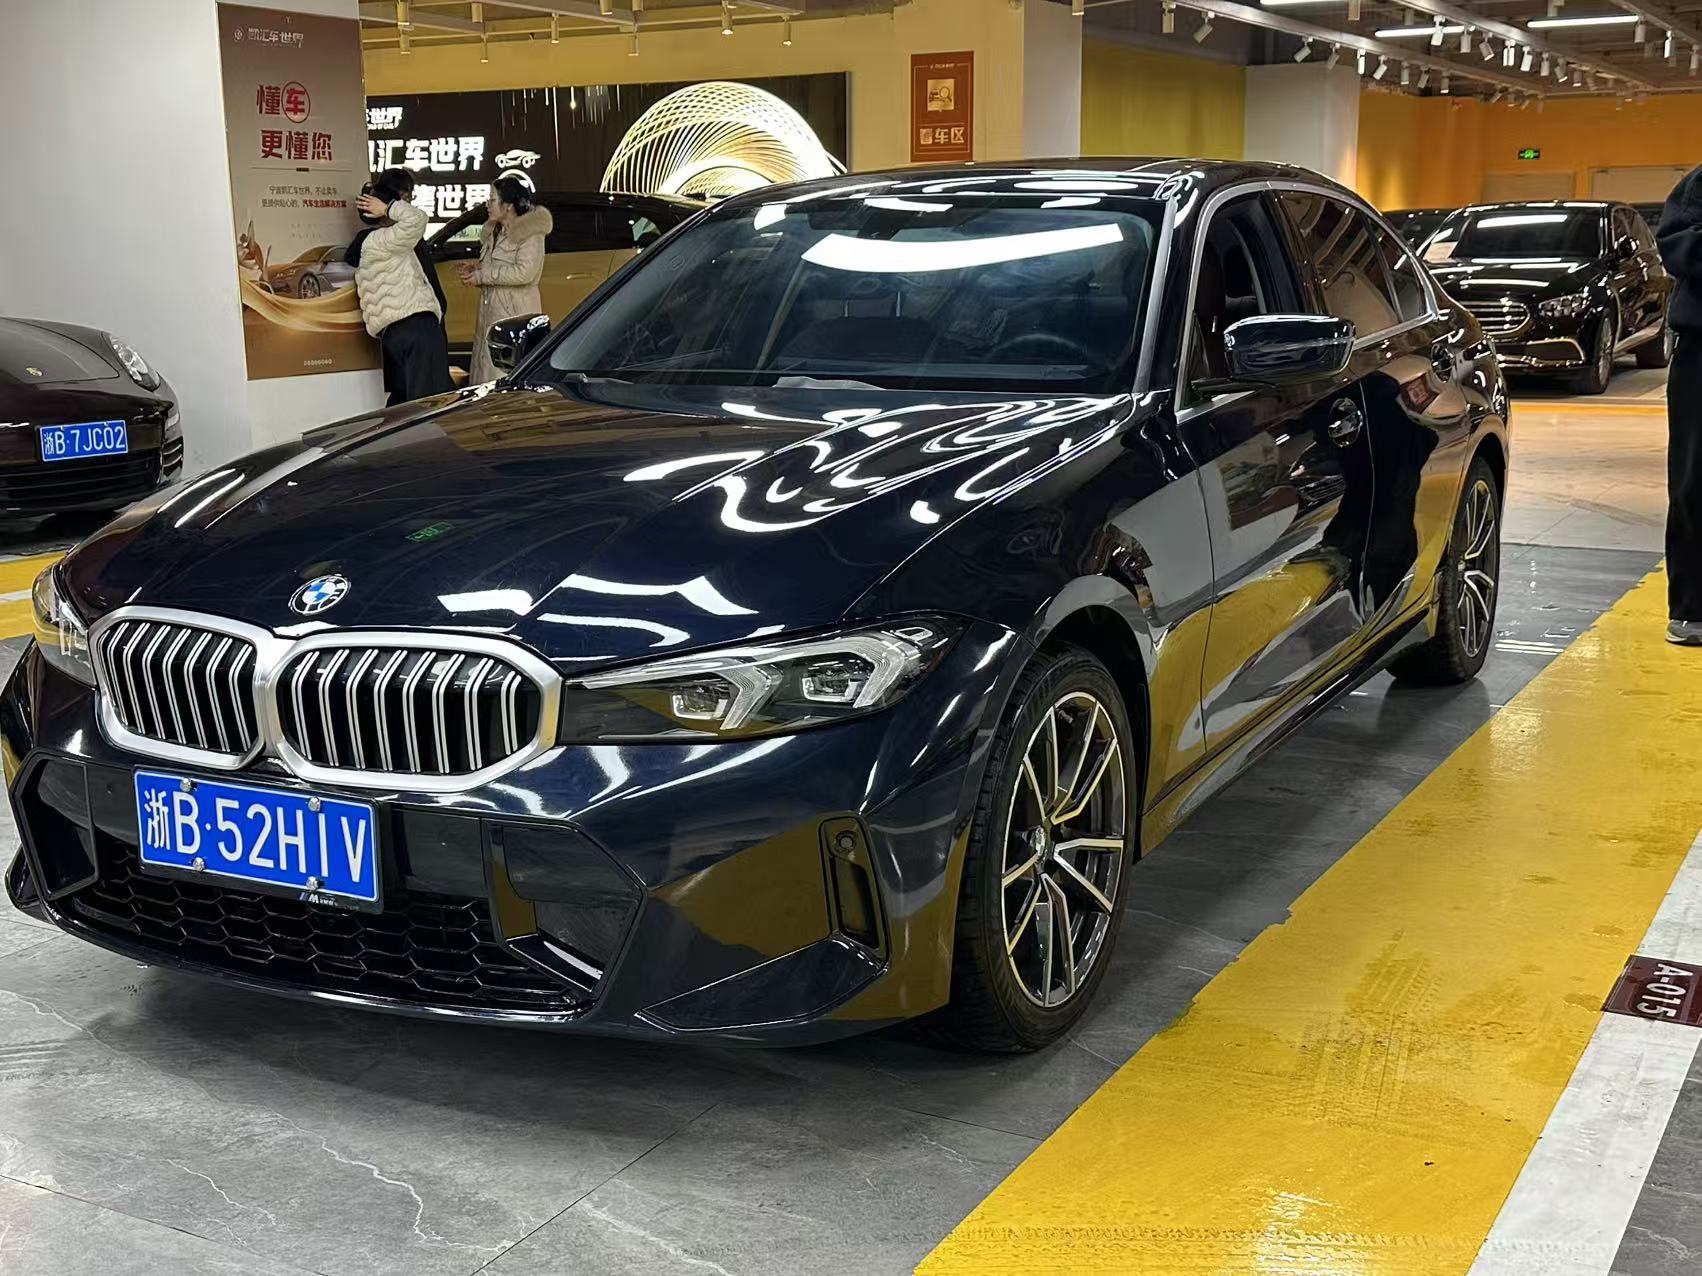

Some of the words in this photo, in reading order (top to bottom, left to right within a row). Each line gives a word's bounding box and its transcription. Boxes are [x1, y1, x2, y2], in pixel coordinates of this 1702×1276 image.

[256, 84, 305, 115] 懂车
[366, 106, 404, 129] 世界
[261, 130, 332, 161] 更懂您
[43, 426, 126, 455] 浙B·7JC02
[1636, 963, 1694, 1017] A-015
